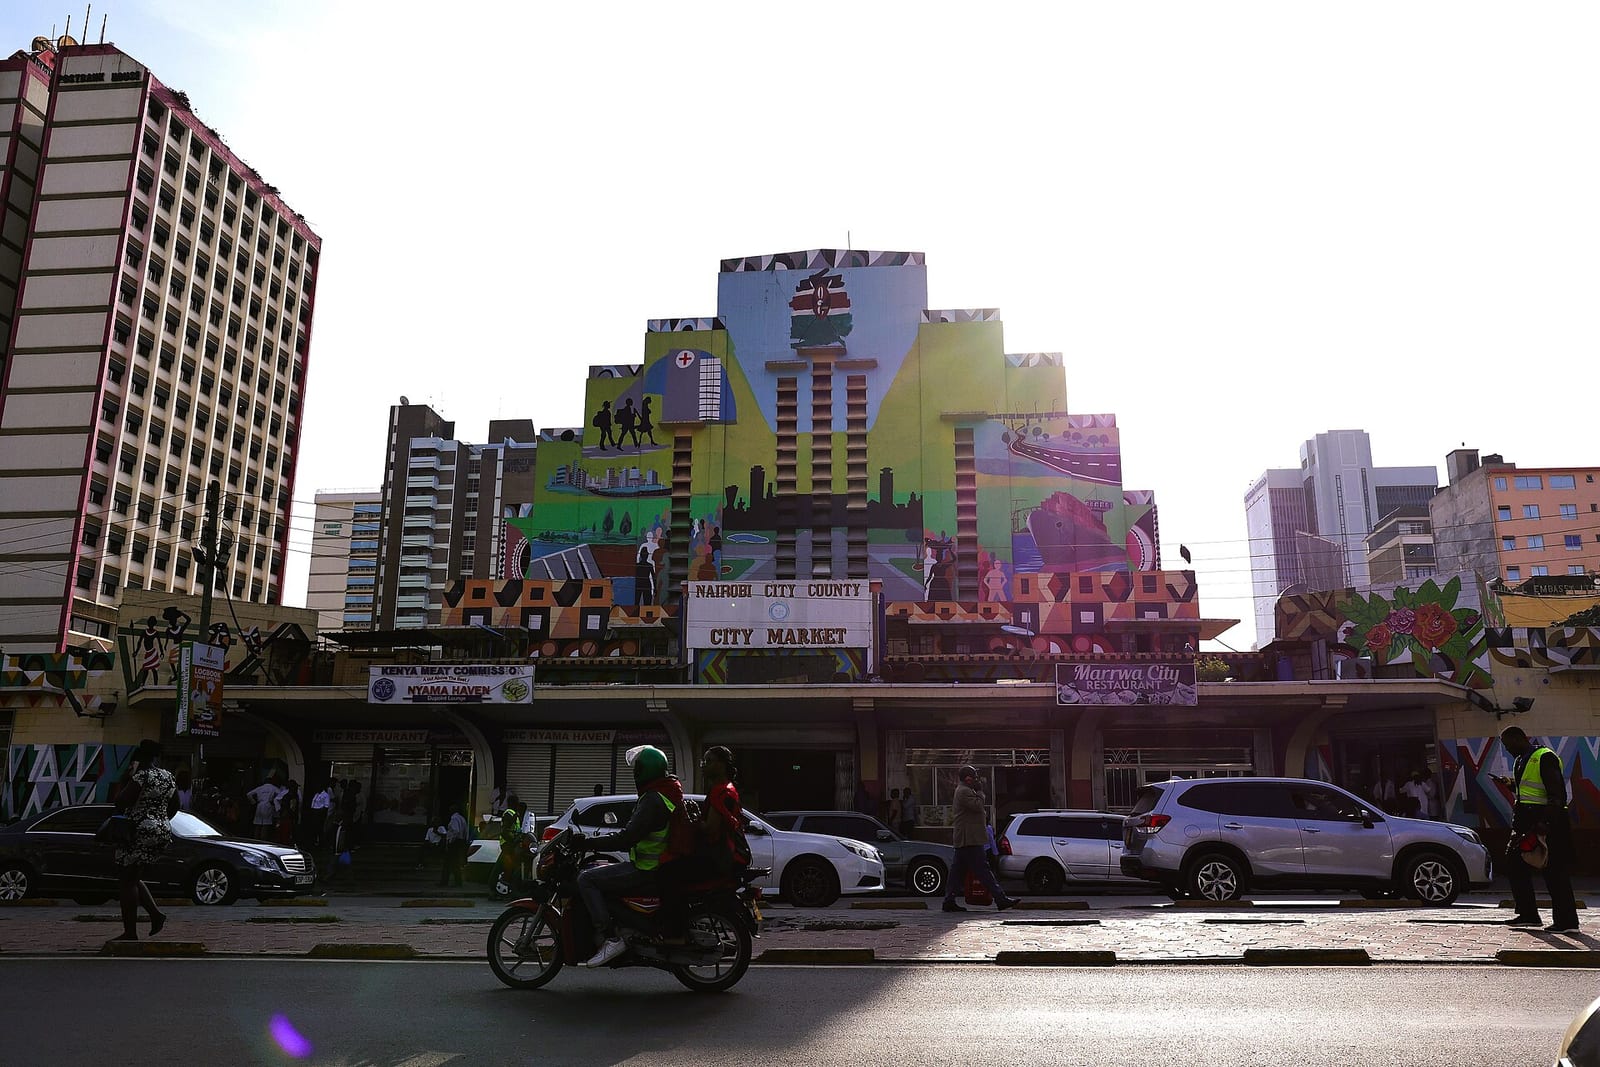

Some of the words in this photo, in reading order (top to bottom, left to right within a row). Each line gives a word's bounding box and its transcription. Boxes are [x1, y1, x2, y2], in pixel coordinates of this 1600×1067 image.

[695, 584, 752, 598] NAIROBI
[764, 584, 796, 598] CITY
[807, 583, 861, 597] COUNTY
[710, 628, 754, 645] CITY
[767, 628, 847, 645] MARKET
[381, 666, 418, 676] KENYA
[420, 666, 453, 676] MEAT
[453, 666, 525, 676] COMMISSION
[1074, 665, 1144, 681] Marrwa
[1147, 665, 1180, 685] City
[408, 685, 448, 695] NYAMA
[452, 685, 490, 695] HAVEN
[1086, 680, 1163, 690] RESTAURANT
[346, 731, 425, 741] RESTAURANT
[529, 731, 569, 741] NYAMA
[573, 731, 610, 742] HAVEN
